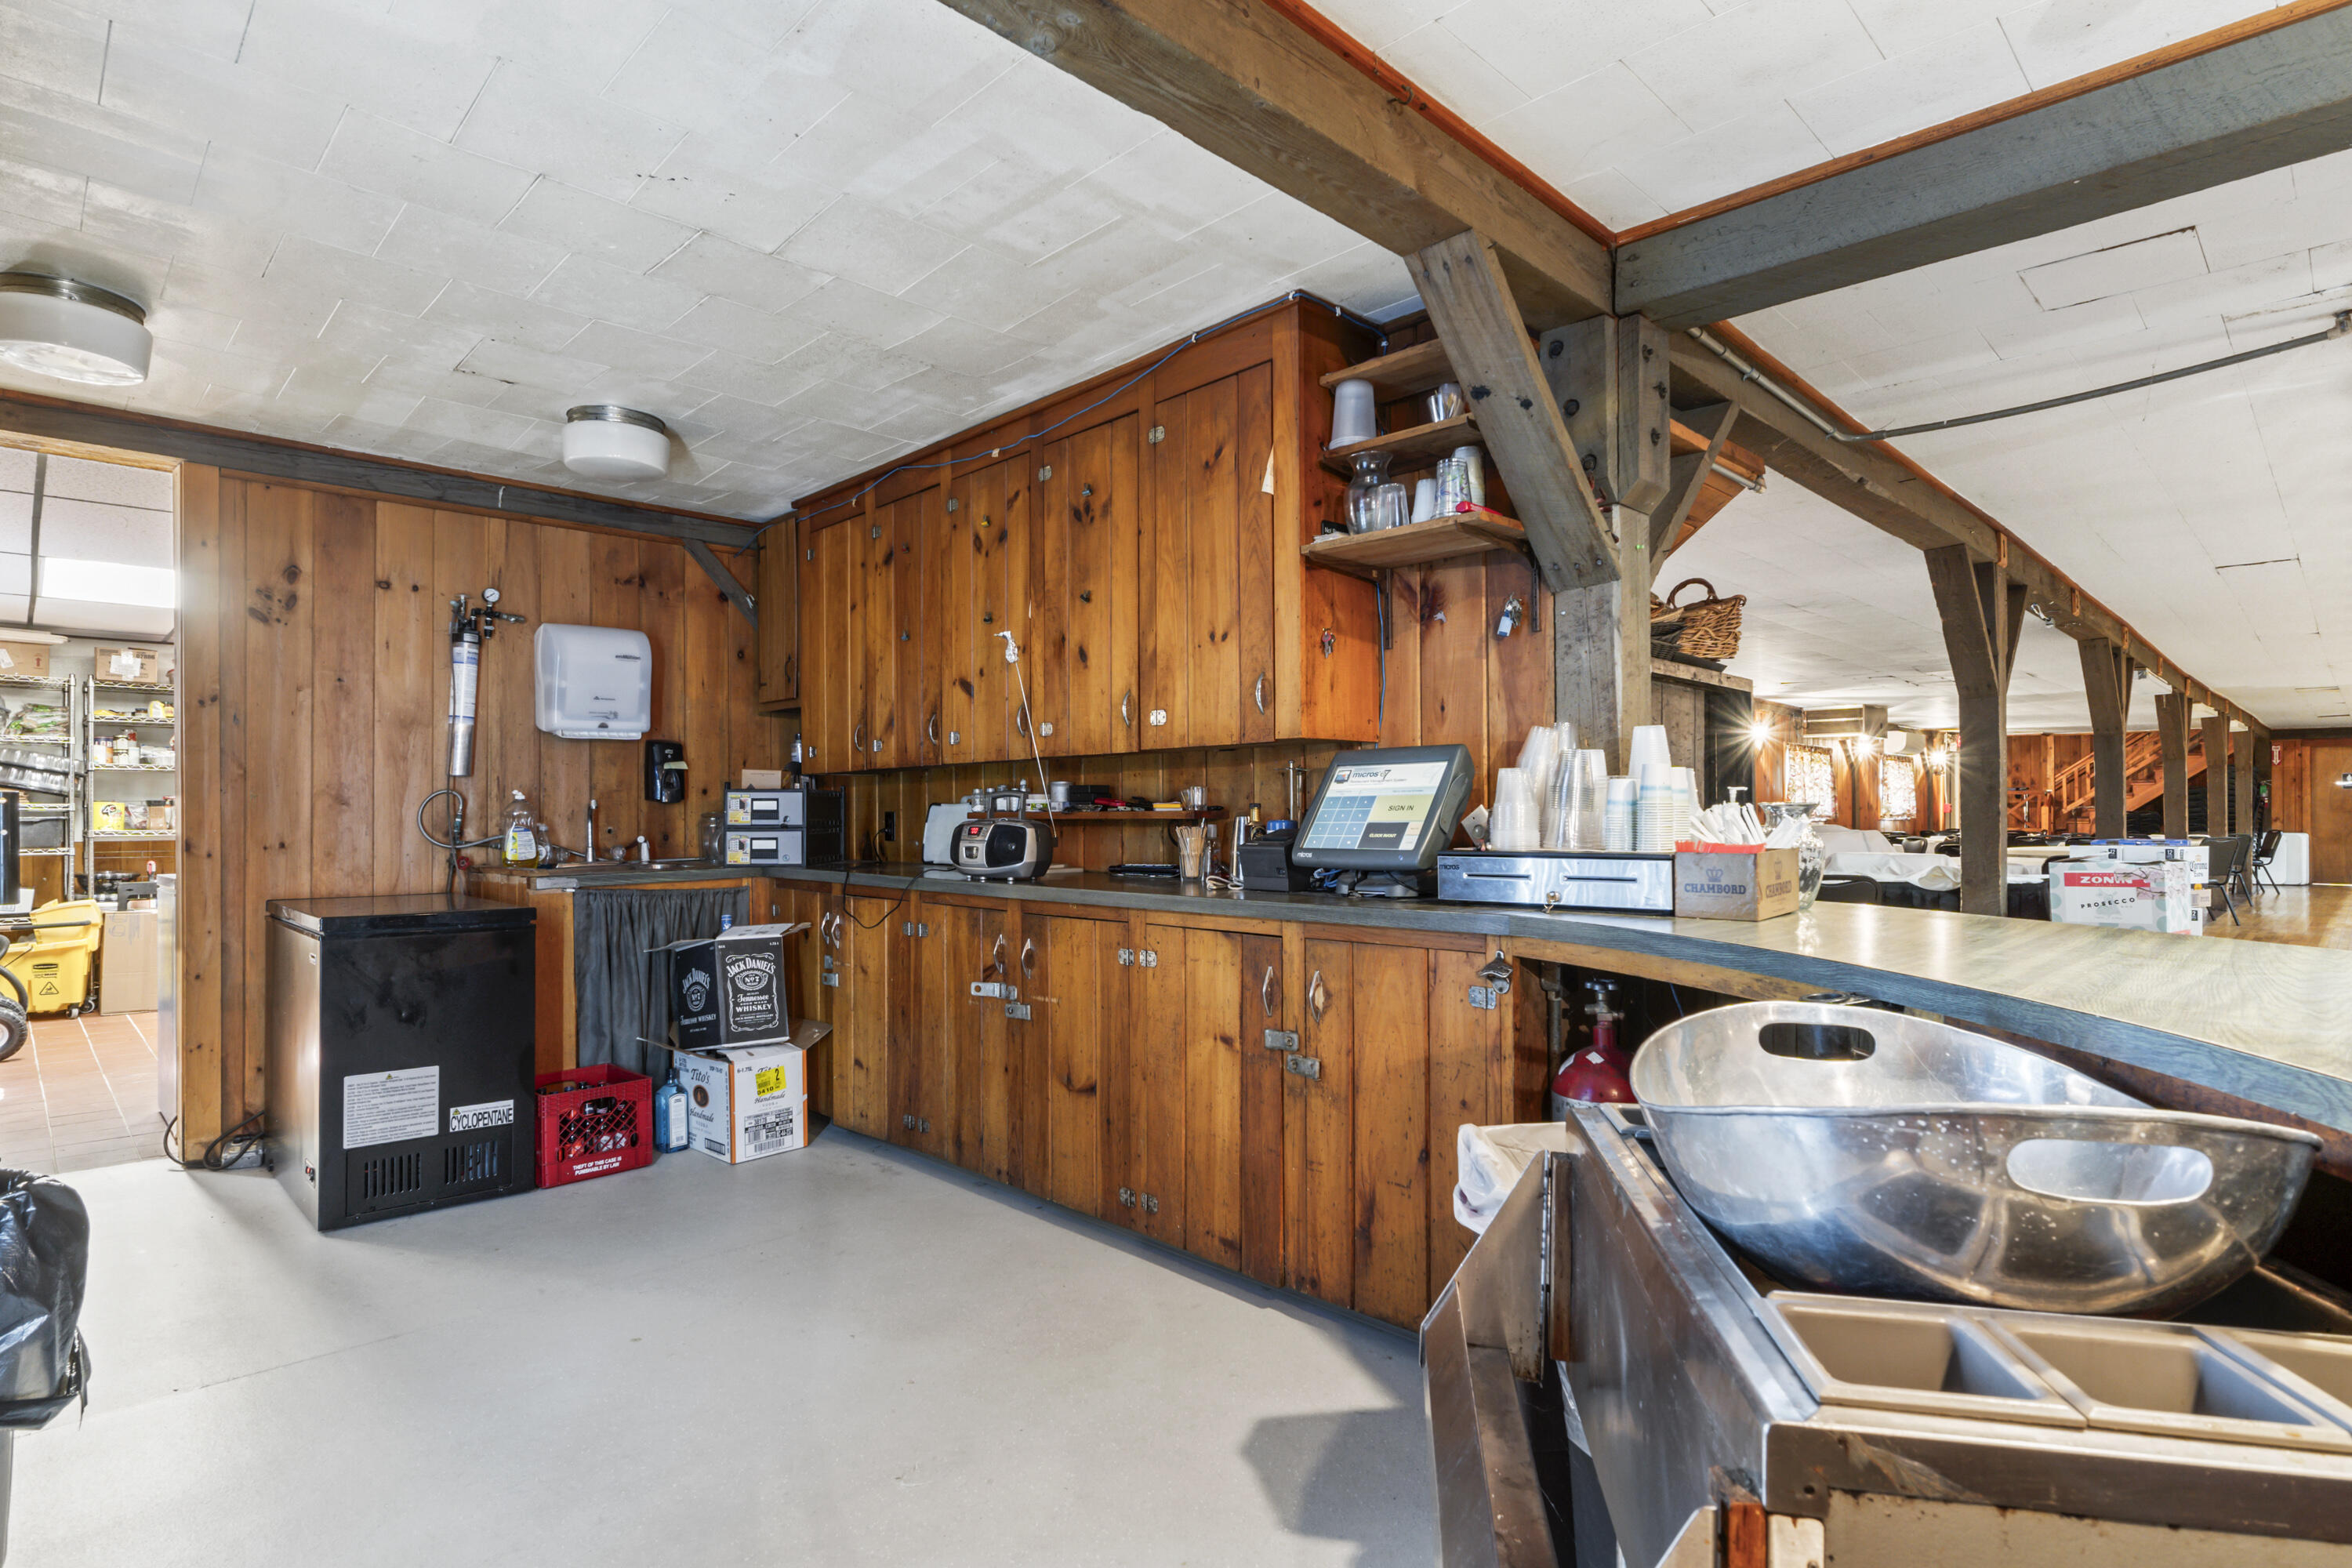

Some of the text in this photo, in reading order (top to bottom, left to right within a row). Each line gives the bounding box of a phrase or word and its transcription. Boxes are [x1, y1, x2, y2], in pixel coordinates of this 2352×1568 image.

[1684, 883, 1747, 895] CHAMBORD
[1766, 880, 1793, 898] CHAMBORD
[2080, 897, 2136, 909] PROSECCO
[726, 957, 776, 978] JACK DANIEL'S
[737, 993, 769, 1003] Tennessee
[735, 1004, 772, 1013] WHISKEY
[698, 1013, 717, 1022] WHISKEY
[691, 1068, 711, 1084] Tito's
[775, 1068, 780, 1081] 2
[754, 1091, 786, 1105] Handmade
[450, 1107, 514, 1131] CYCLOPENTANE
[689, 1107, 714, 1123] Handmade
[575, 1165, 603, 1176] PUNISHABLE
